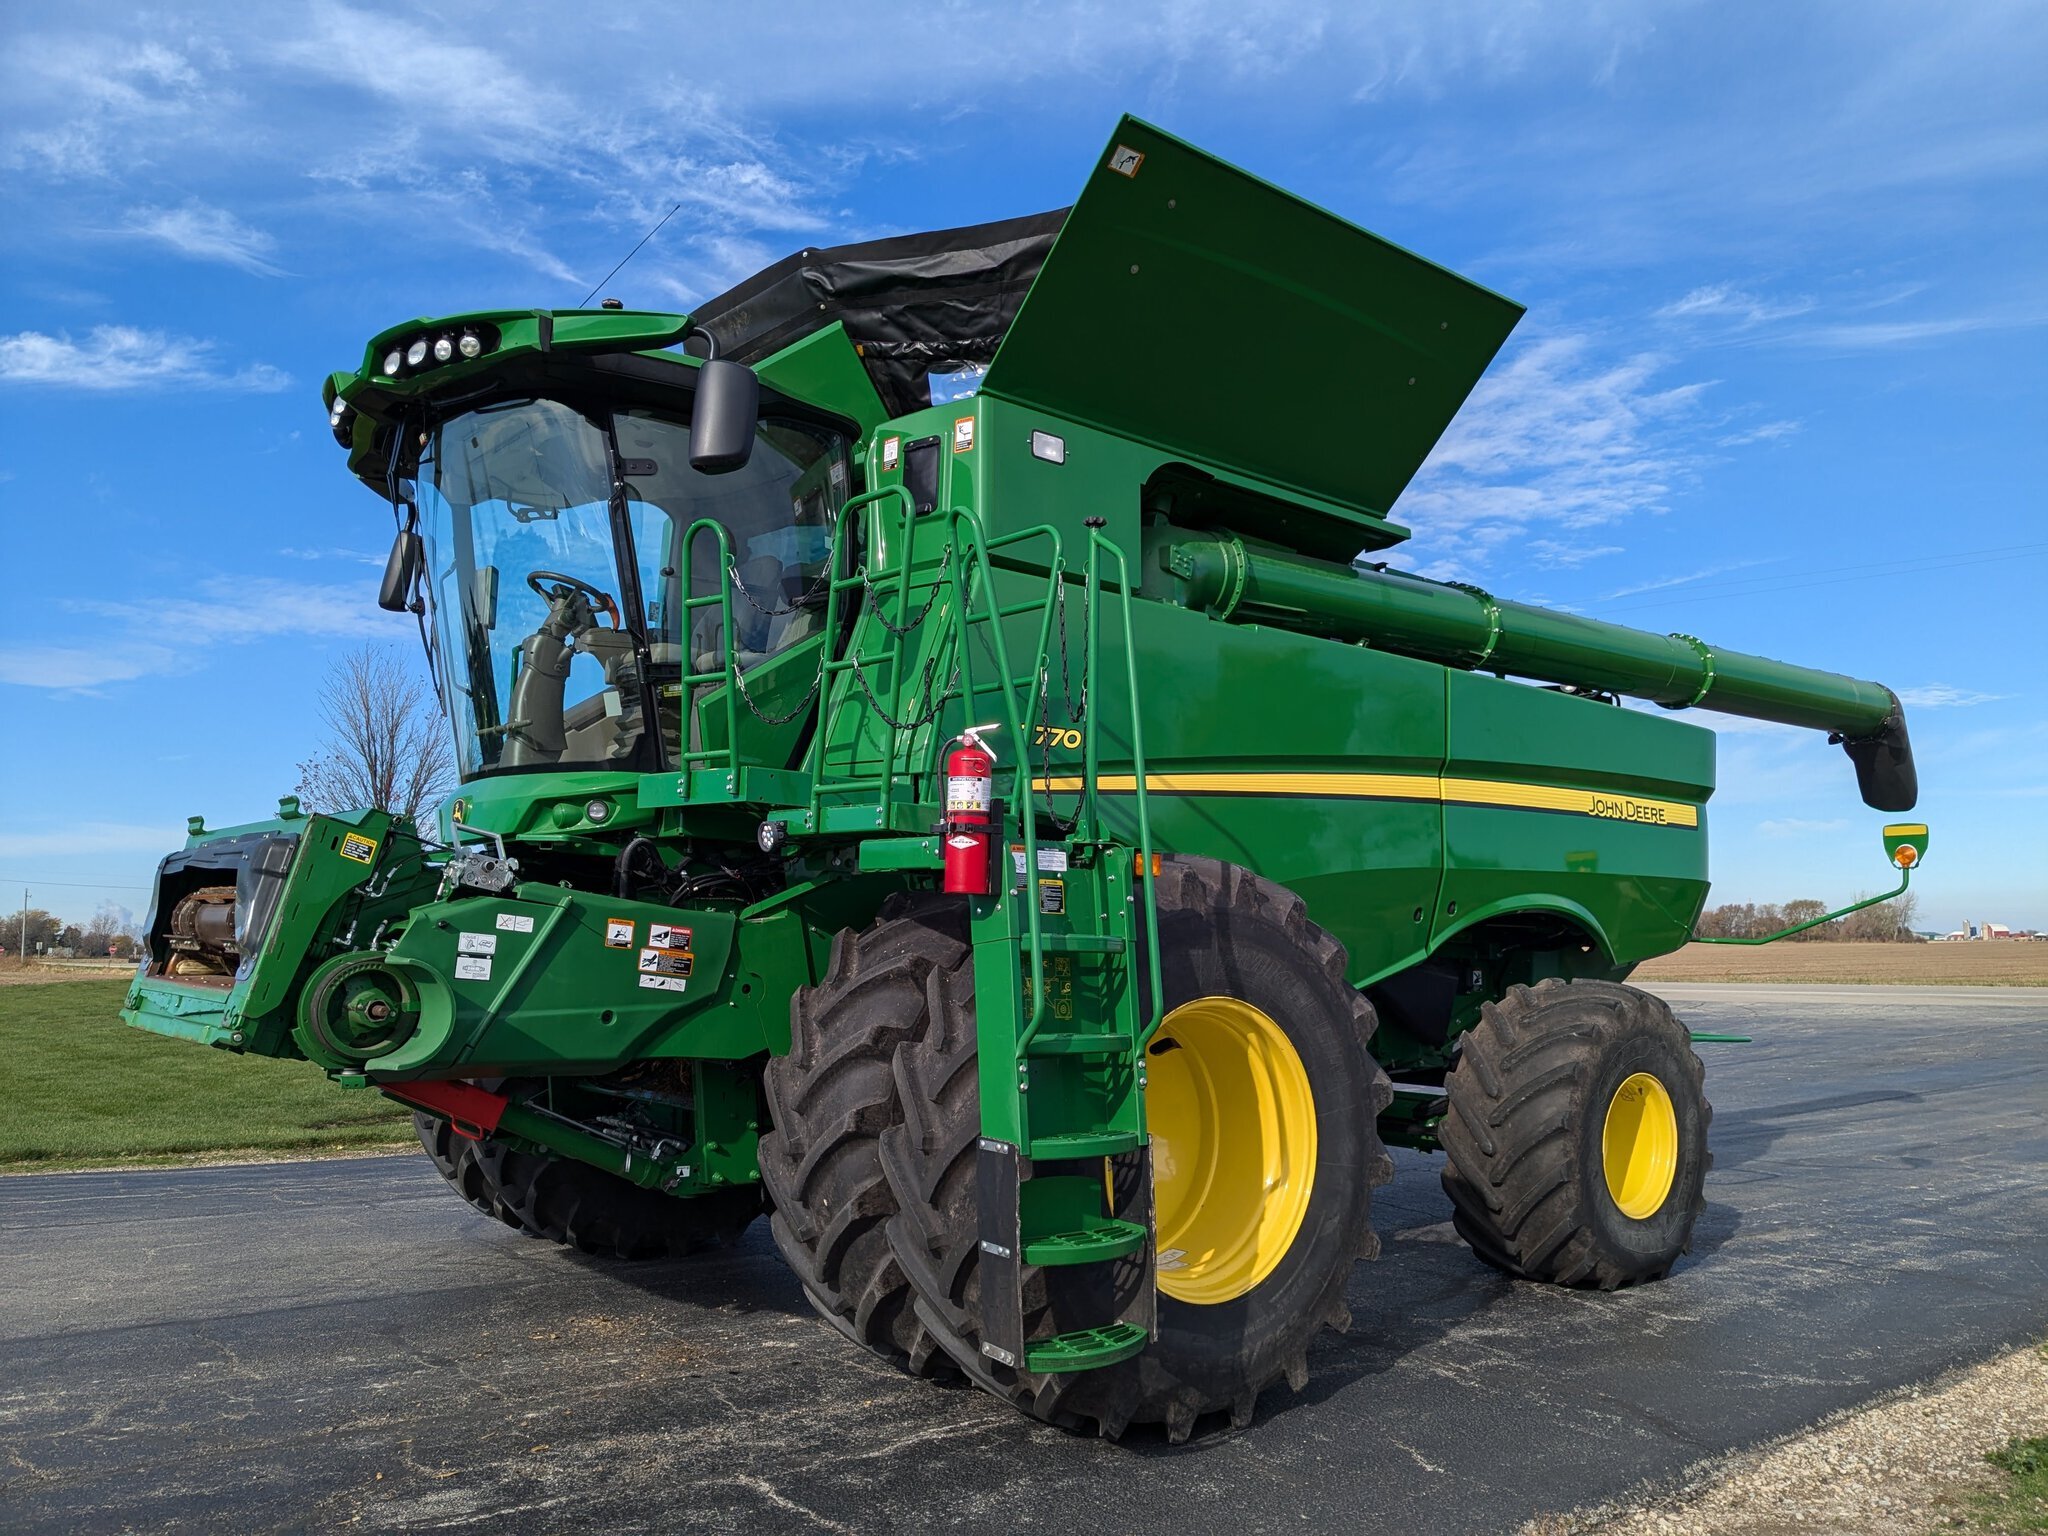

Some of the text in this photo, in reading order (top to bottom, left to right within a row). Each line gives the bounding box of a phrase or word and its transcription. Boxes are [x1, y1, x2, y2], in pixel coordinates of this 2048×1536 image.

[1021, 724, 1082, 749] 770
[1589, 796, 1666, 822] JOHN DEERE
[352, 835, 376, 846] CAUTION
